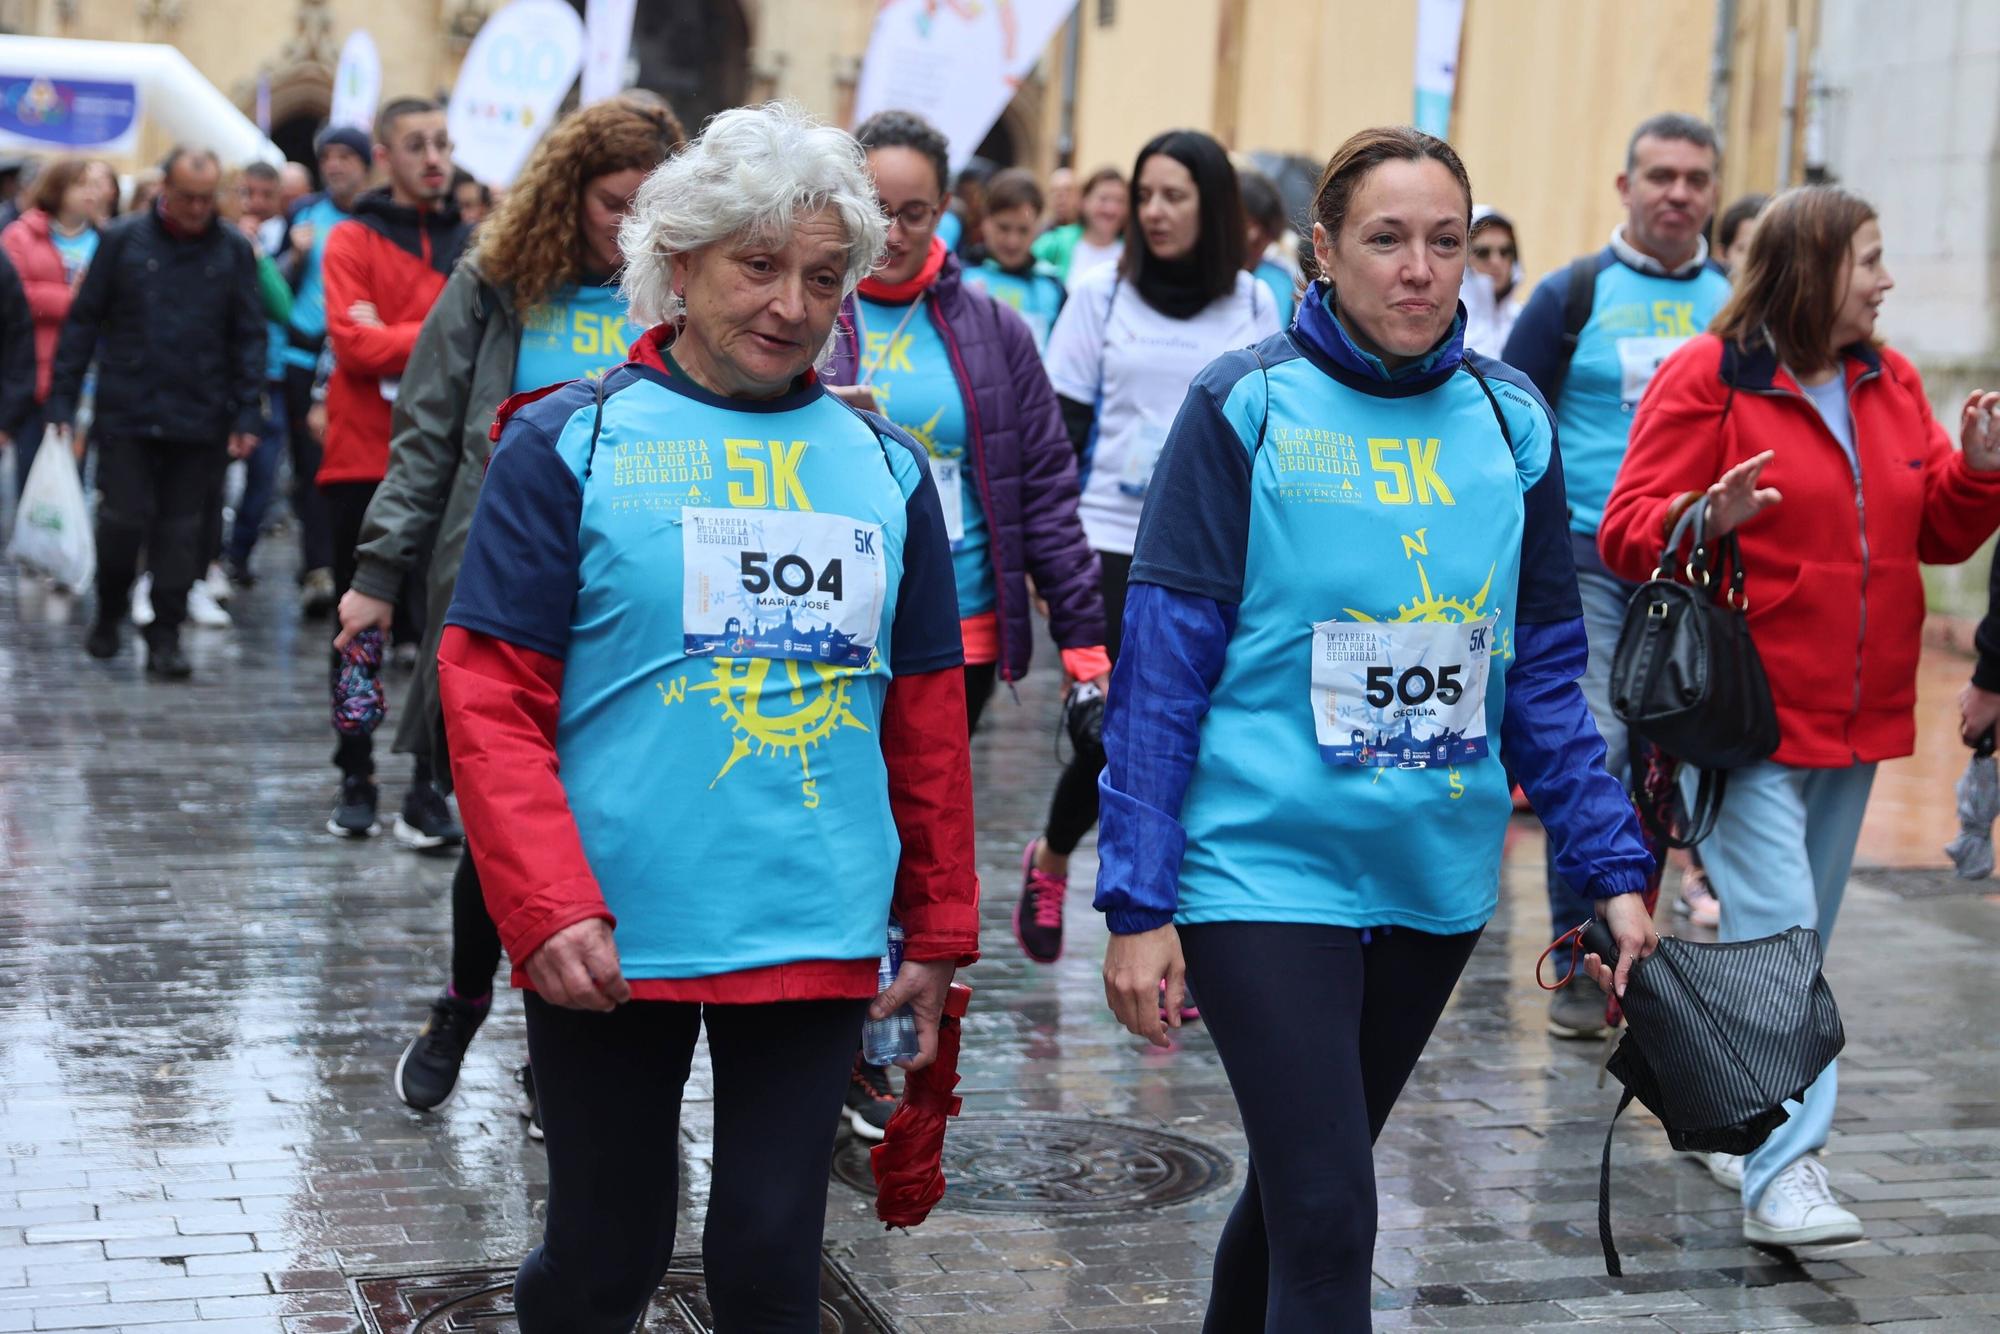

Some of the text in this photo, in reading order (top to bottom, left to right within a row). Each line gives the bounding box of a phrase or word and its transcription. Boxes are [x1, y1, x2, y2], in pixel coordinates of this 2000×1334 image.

[1653, 300, 1698, 338] 5K
[573, 310, 628, 356] 5K
[860, 331, 915, 372] 5K
[615, 439, 708, 458] IV CARRERA
[1273, 428, 1356, 448] IV CARRERA
[615, 451, 710, 472] RUTA POR LA
[1277, 440, 1358, 462] RUTA POR LA
[614, 465, 712, 487] SEGURIDAD
[723, 438, 814, 512] 5K
[1278, 455, 1361, 477] SEGURIDAD
[1367, 438, 1456, 505] 5K
[697, 525, 749, 536] RUTA POR LA
[708, 518, 748, 526] CARRERA
[697, 534, 750, 546] SEGURIDAD
[854, 529, 875, 556] 5K
[741, 551, 843, 601] 504
[756, 595, 830, 611] MARÍA JOSÉ
[1327, 632, 1376, 641] IV CARRERA
[1327, 642, 1376, 651] RUTA POR LA
[1469, 627, 1488, 652] 5K
[1327, 651, 1377, 661] SEGURIDAD
[1366, 664, 1463, 709] 505
[1393, 708, 1437, 719] CECILIA
